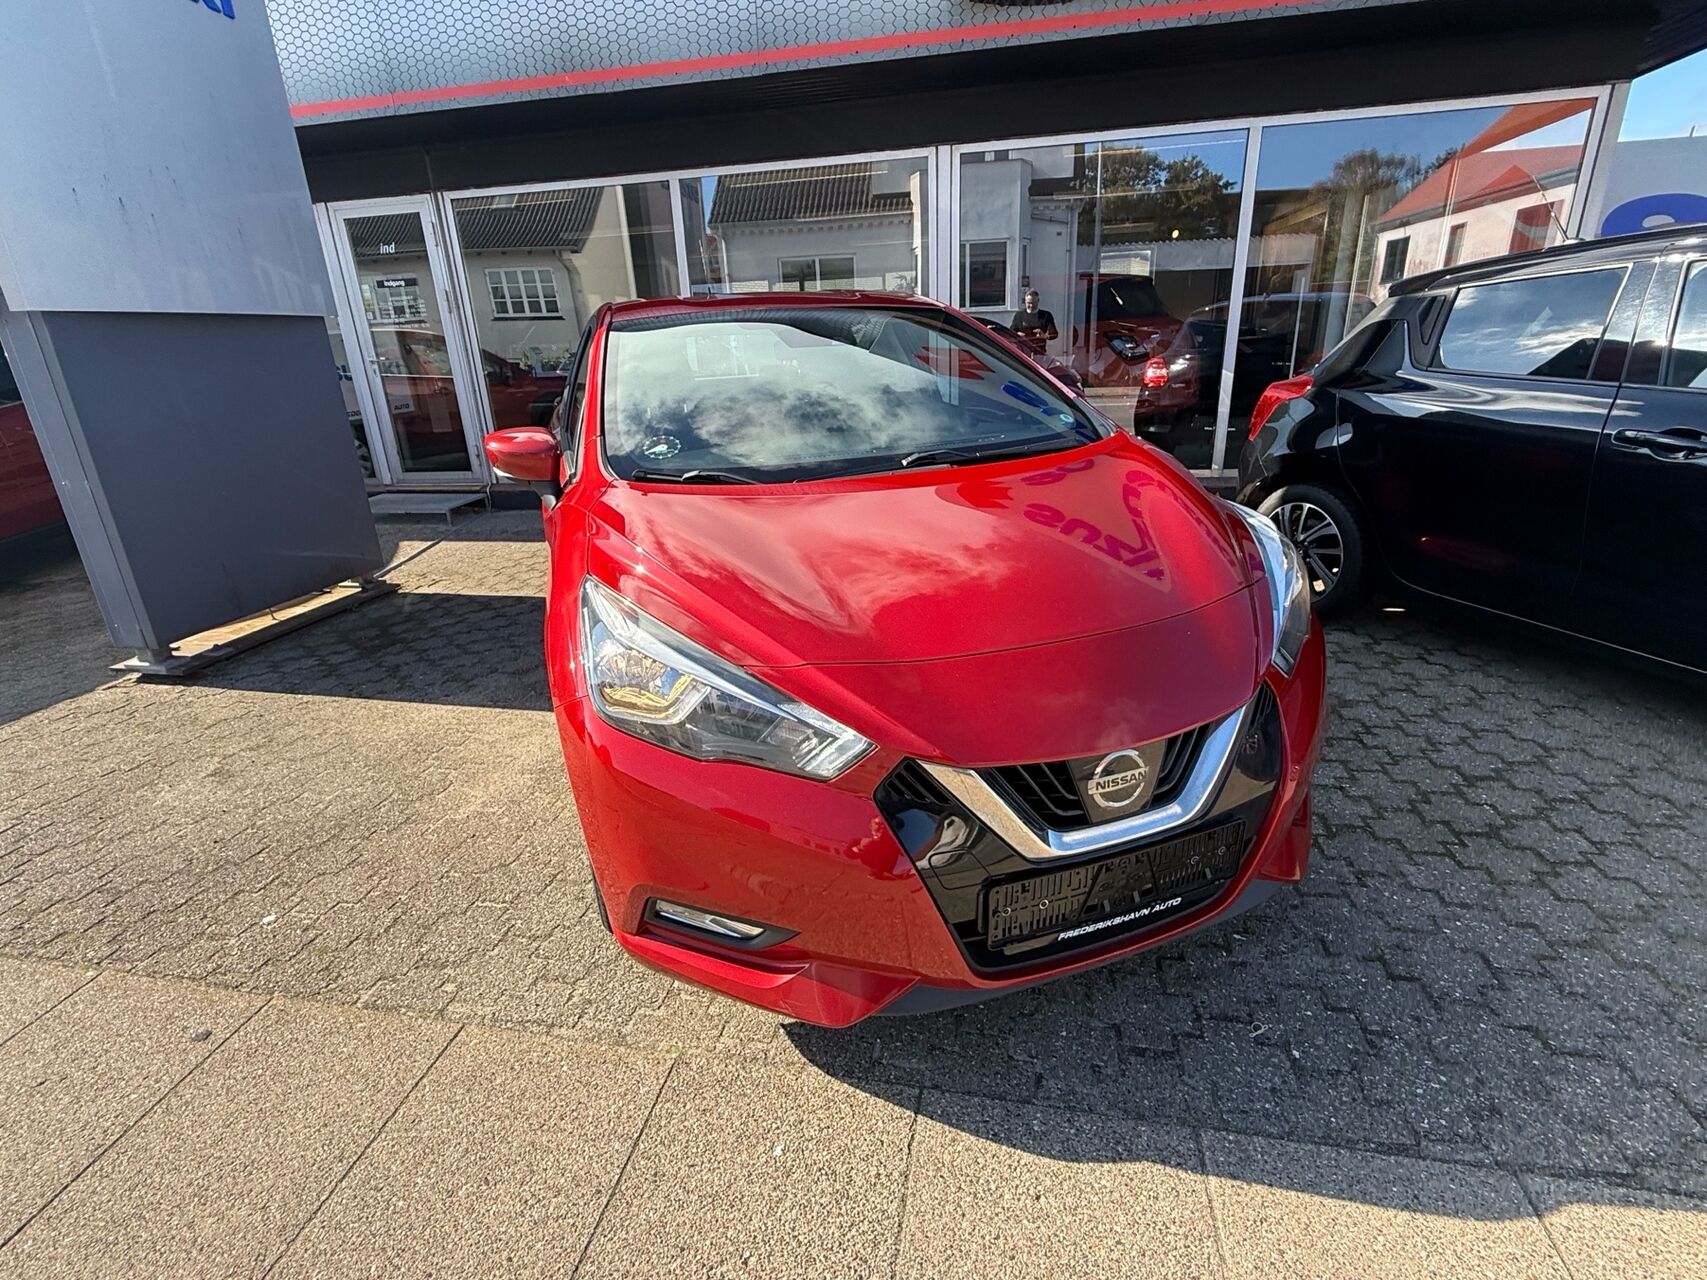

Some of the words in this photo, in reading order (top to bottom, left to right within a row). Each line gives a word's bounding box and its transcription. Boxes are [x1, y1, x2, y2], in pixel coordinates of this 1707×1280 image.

[380, 242, 396, 254] ind
[1095, 769, 1147, 791] NISSAN
[1058, 906, 1150, 941] FREDERIKSHAVN
[1152, 897, 1182, 913] AUTO
